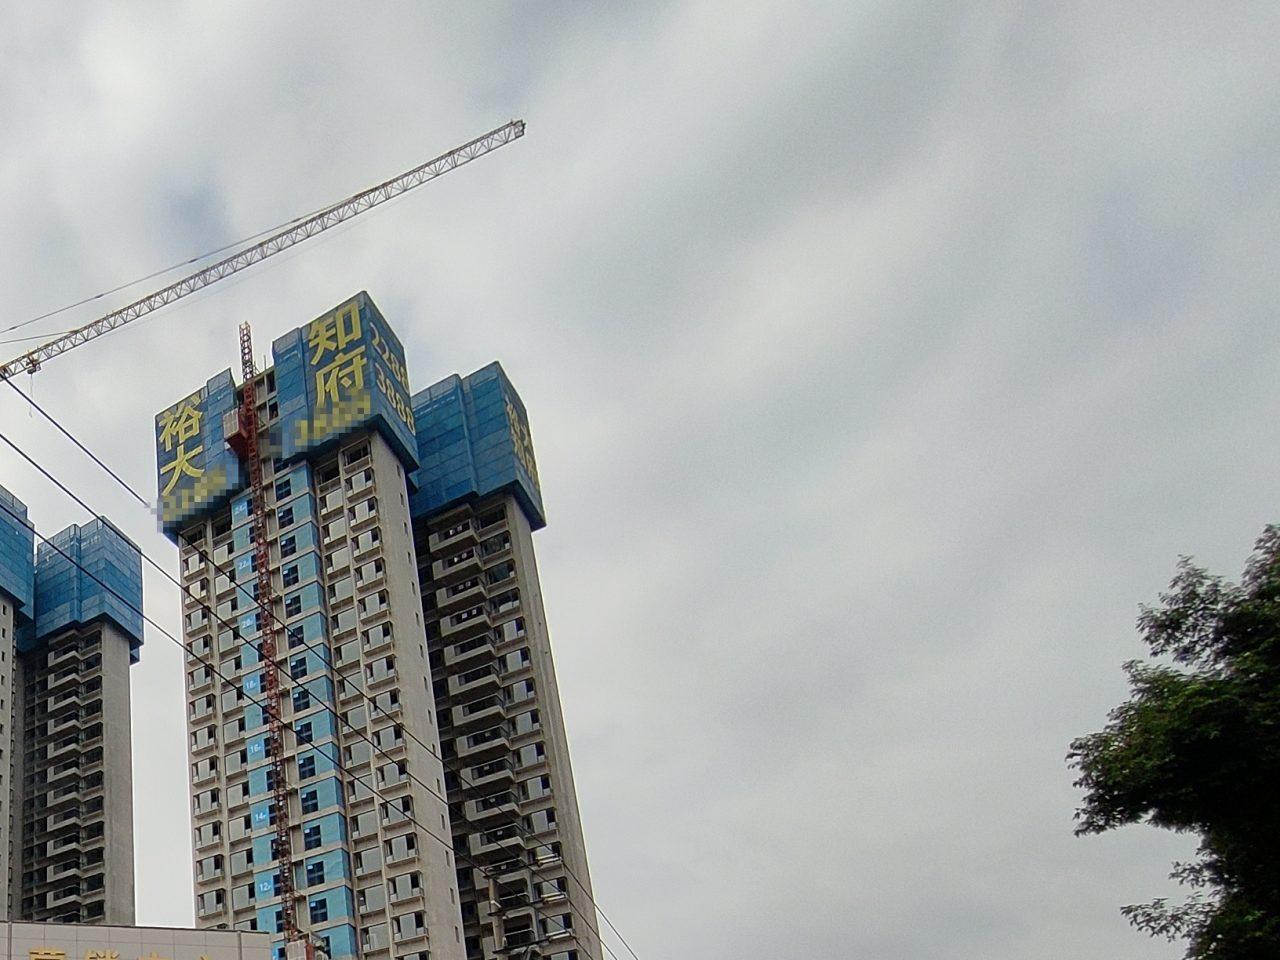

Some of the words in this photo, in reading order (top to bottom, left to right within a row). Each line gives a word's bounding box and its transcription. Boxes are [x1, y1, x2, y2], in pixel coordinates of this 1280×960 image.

[309, 302, 367, 408] 知府
[369, 322, 410, 395] 2288
[374, 361, 416, 437] 3888
[159, 395, 205, 497] 裕大
